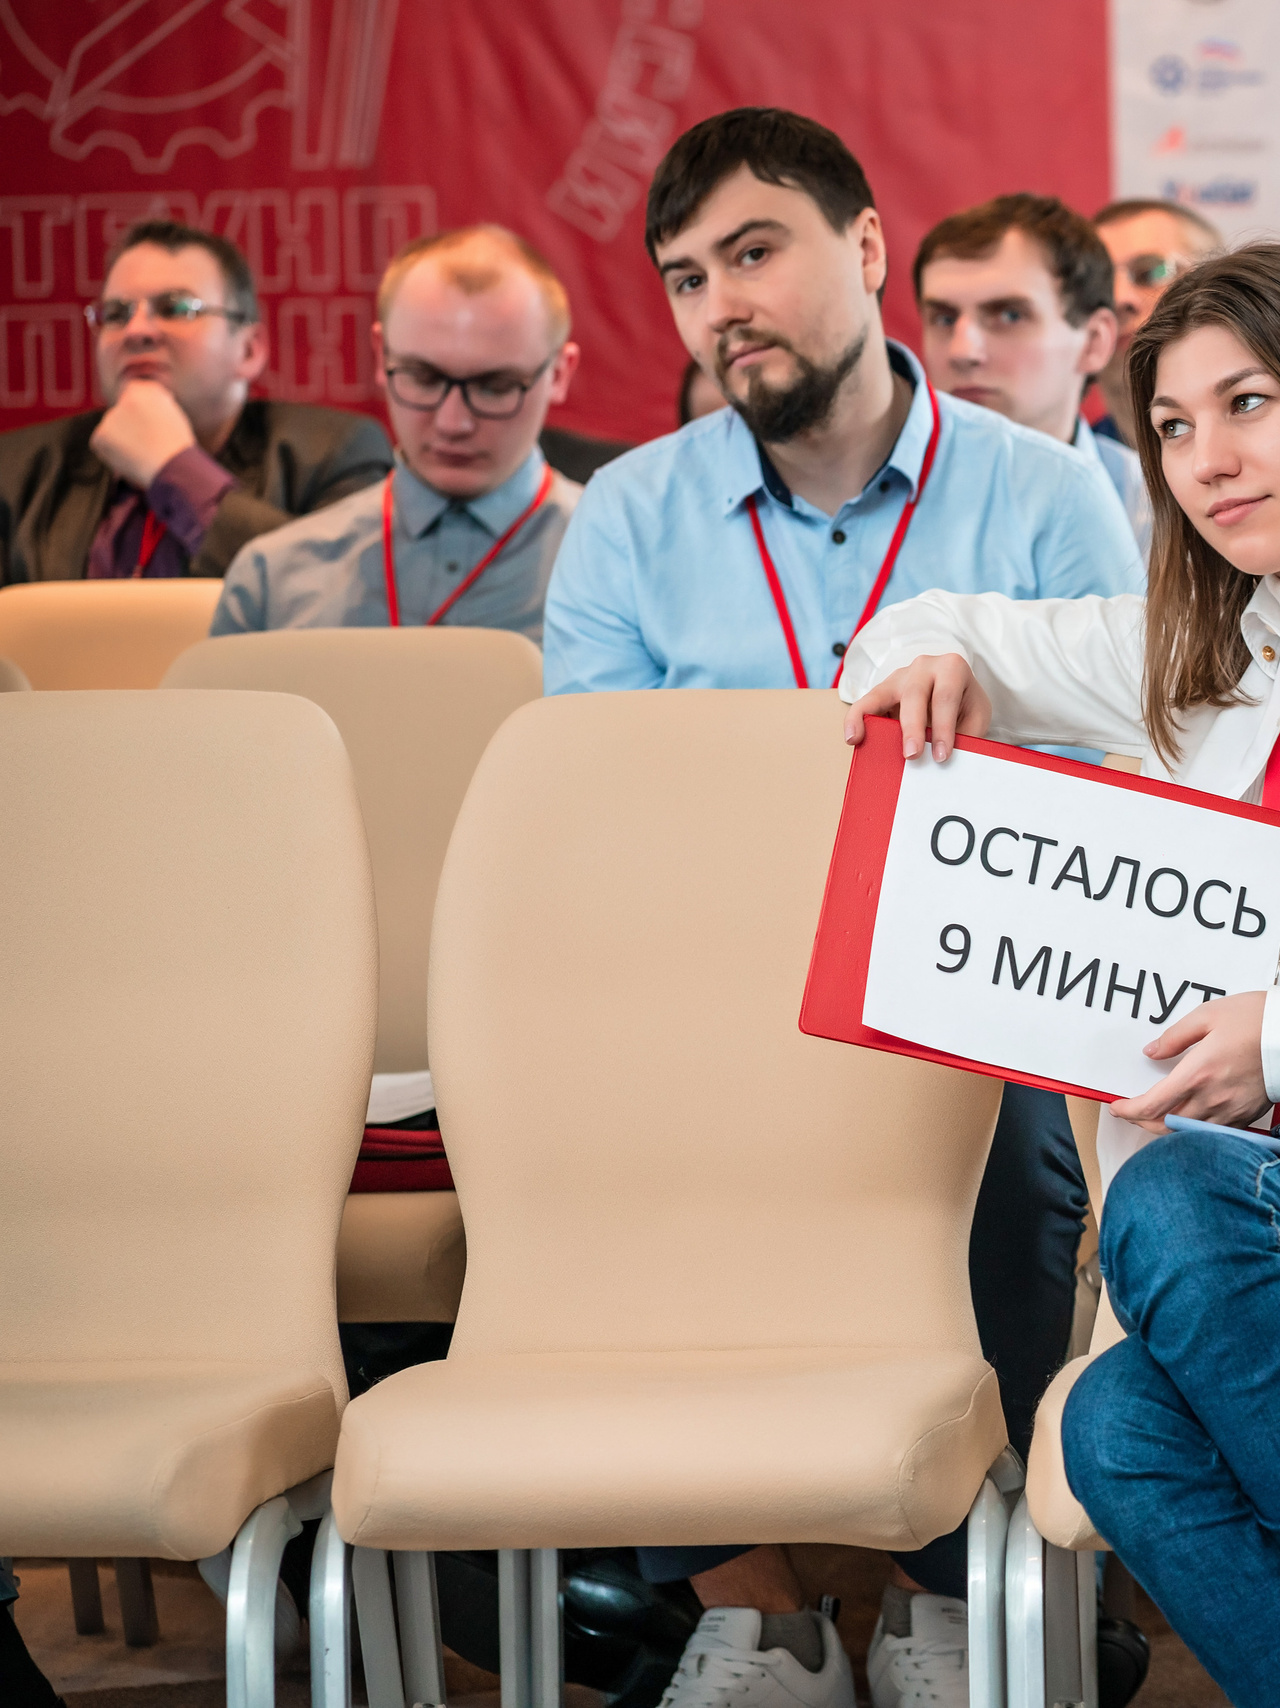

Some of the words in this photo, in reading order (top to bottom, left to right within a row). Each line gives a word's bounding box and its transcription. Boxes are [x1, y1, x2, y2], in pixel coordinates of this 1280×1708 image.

[929, 814, 1267, 939] ОСТАЛОСЬ
[935, 922, 972, 975] 9
[990, 934, 1228, 1026] МИНУТ
